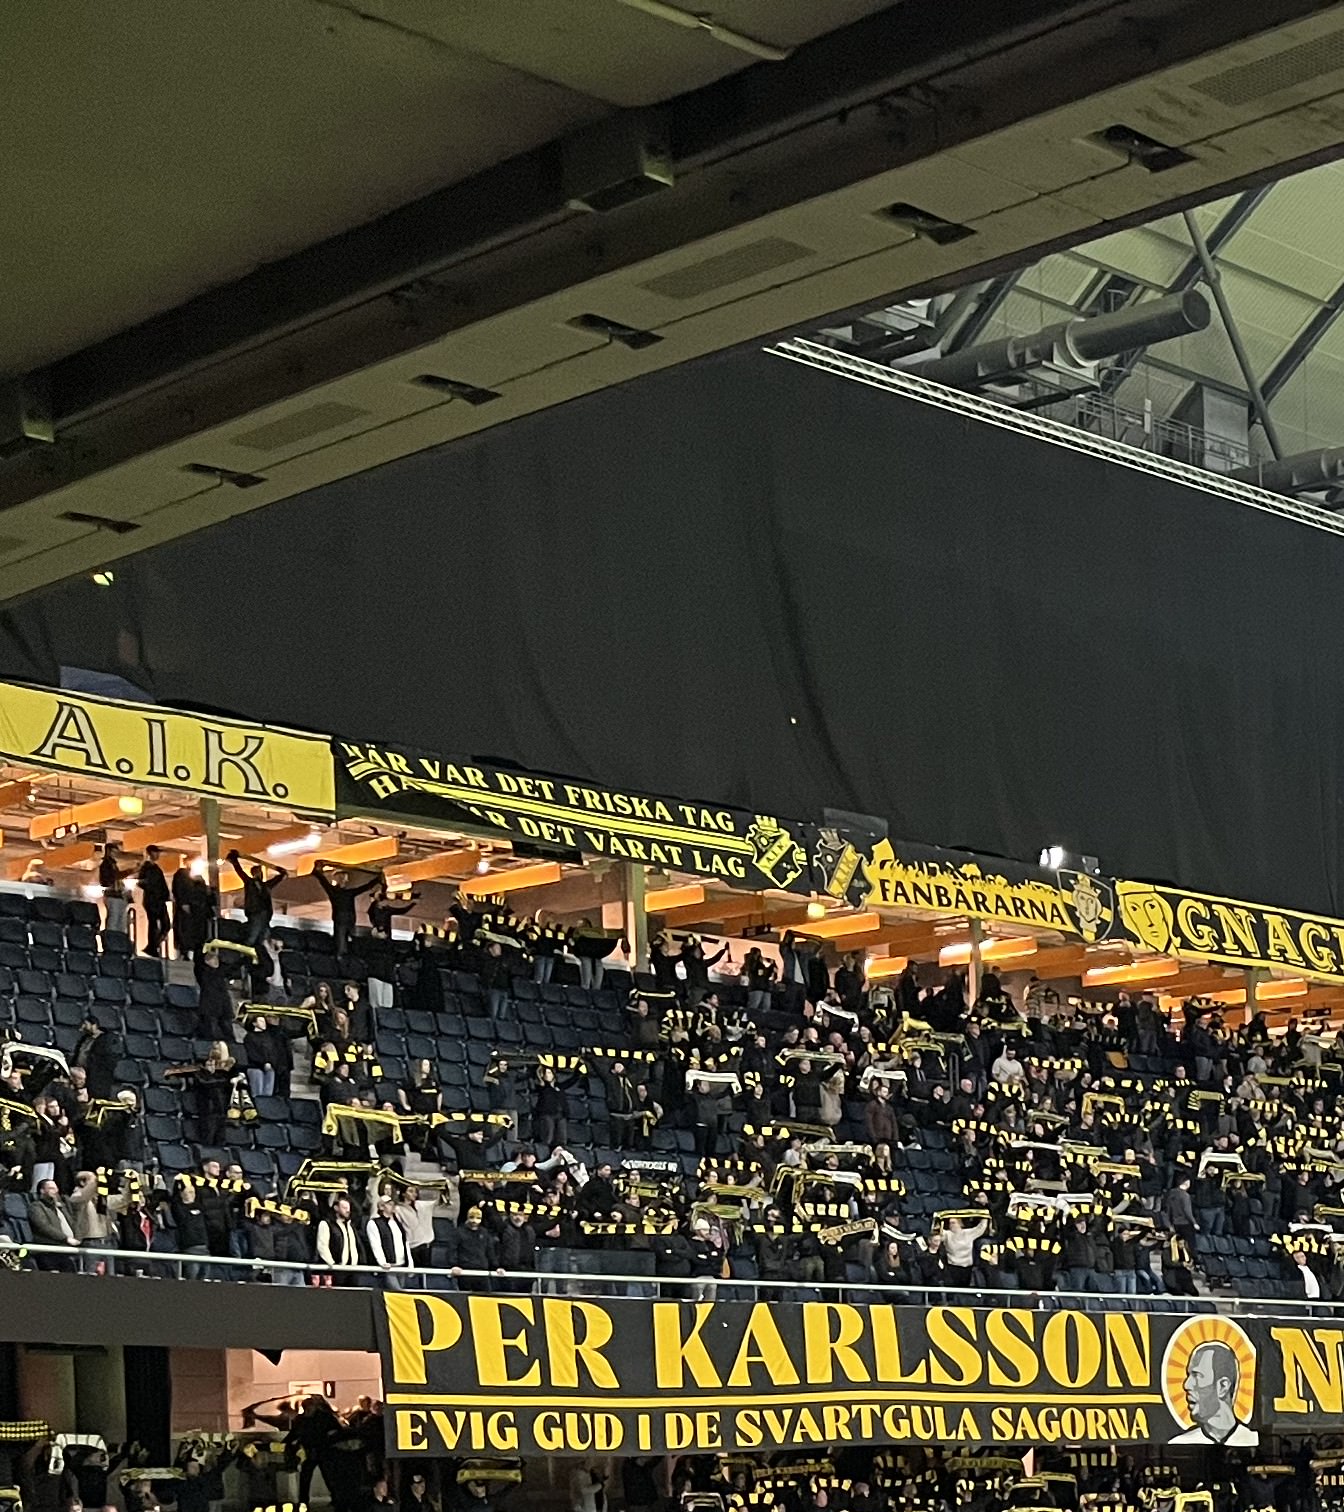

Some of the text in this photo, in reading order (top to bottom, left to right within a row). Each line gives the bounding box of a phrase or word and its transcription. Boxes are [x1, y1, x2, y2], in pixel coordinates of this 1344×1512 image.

[34, 701, 289, 799] A.I.K.
[340, 742, 736, 833] NÄR VAR DET FRISKA TAG
[368, 775, 421, 800] HA
[518, 816, 576, 848] DET
[584, 830, 683, 867] VÅRAT
[693, 849, 746, 879] LAG
[879, 878, 1069, 927] FANBÄRARNA
[383, 1291, 1151, 1390] PER KARLSSON
[398, 1405, 1150, 1452] EVIG GUD I DE SVARTGULA SAGORNA
